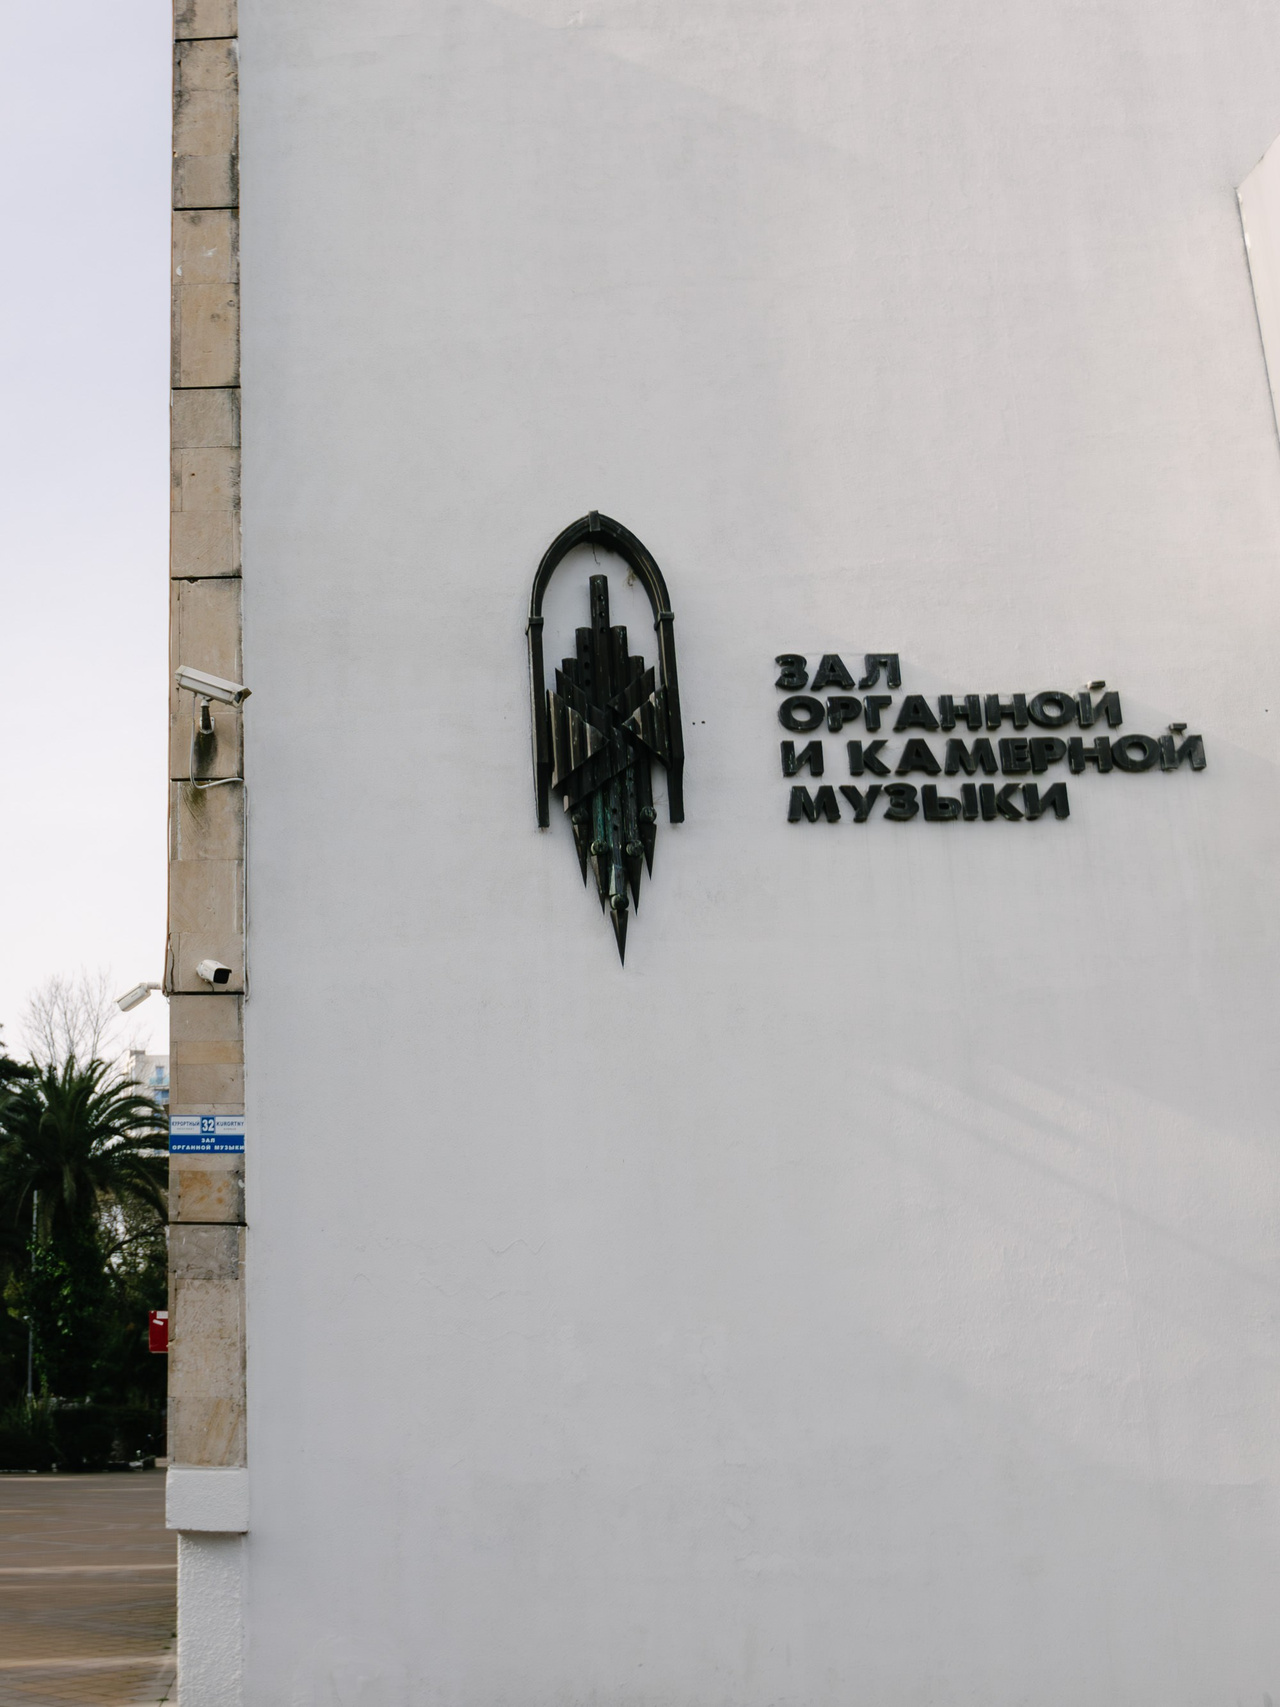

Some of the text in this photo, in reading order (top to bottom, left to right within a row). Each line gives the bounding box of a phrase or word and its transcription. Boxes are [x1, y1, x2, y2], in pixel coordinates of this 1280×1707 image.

[775, 653, 901, 691] ЗАЛ
[778, 680, 1123, 733] ОРГАННОЙ
[780, 722, 1207, 778] И КАМЕРНОЙ
[787, 782, 1071, 823] МУЗЫКИ
[202, 1119, 215, 1132] 32
